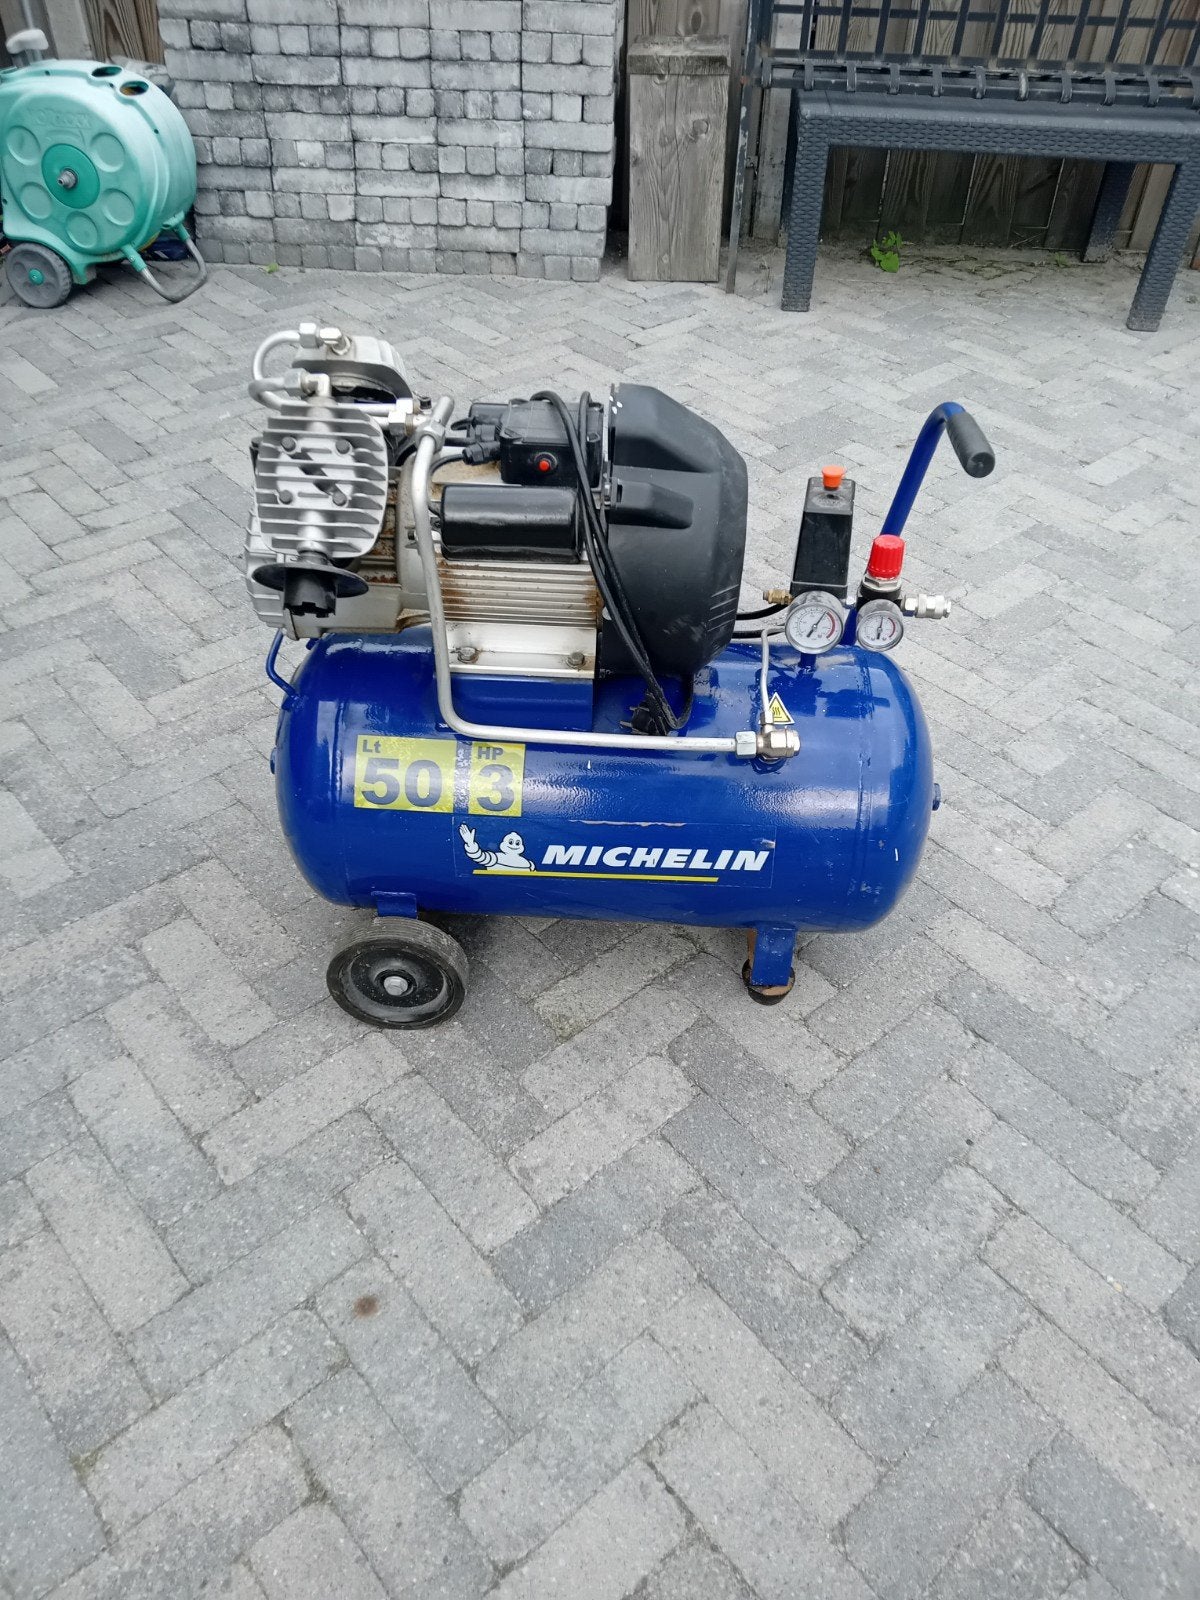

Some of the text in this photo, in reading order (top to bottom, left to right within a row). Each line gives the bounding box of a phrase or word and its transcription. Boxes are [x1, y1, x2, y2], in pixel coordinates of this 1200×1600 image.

[362, 739, 382, 754] Lt
[477, 746, 504, 760] HP
[361, 757, 443, 808] 50
[476, 763, 515, 812] 3
[541, 844, 770, 871] MICHELIN
